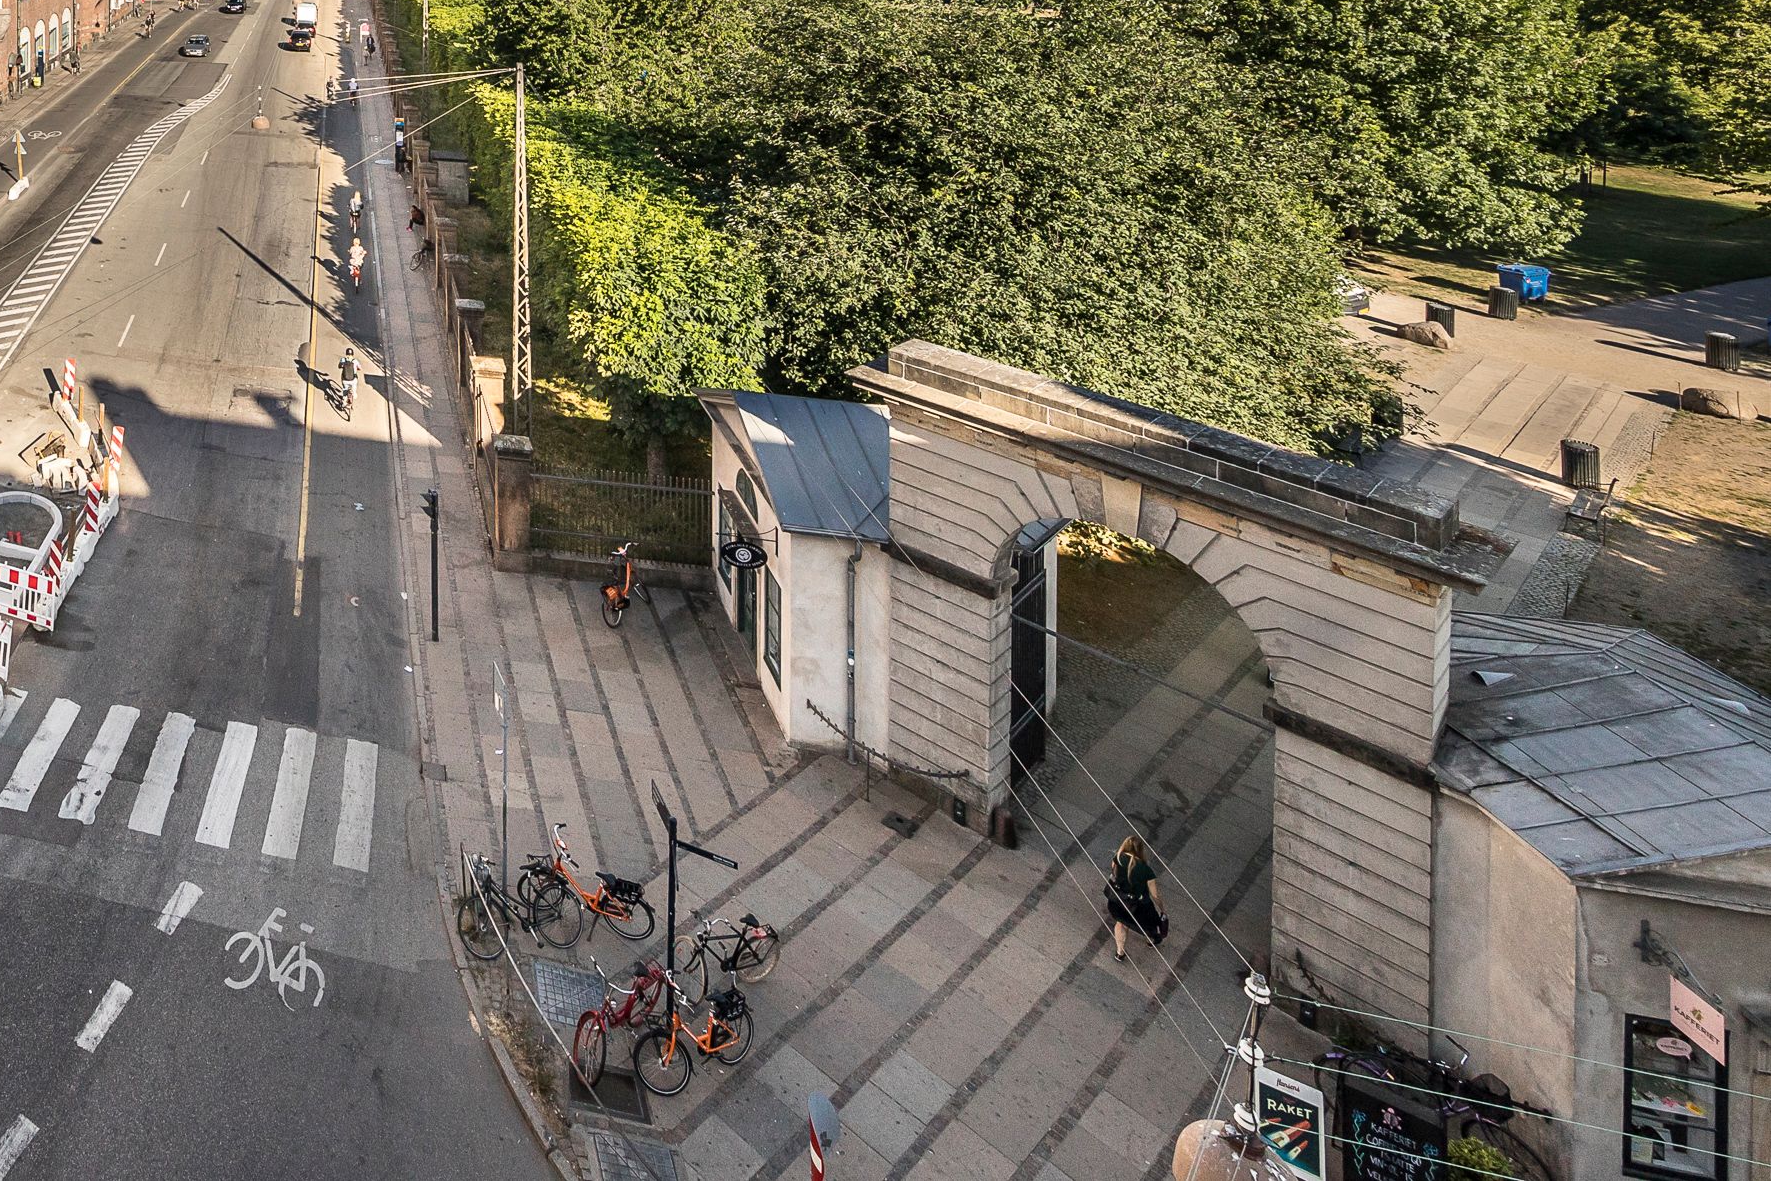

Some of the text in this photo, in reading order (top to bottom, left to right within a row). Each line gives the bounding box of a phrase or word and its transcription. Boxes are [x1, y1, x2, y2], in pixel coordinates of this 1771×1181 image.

[1674, 1005, 1720, 1045] KAFFERIET
[1266, 1098, 1313, 1120] RAKET
[1371, 1122, 1417, 1150] KAFFERIET
